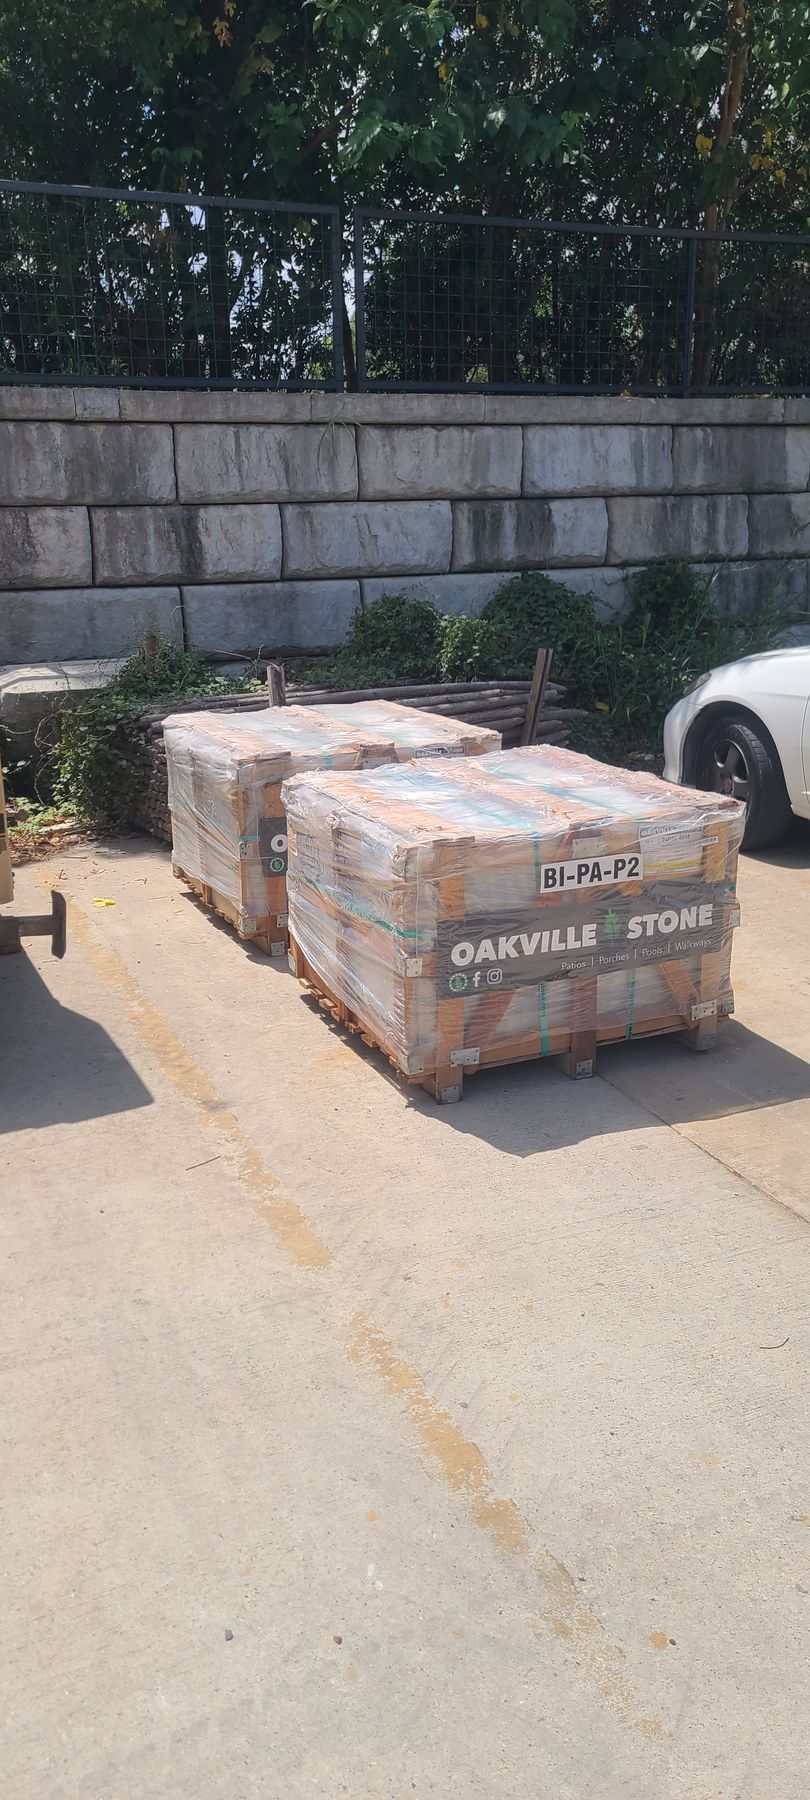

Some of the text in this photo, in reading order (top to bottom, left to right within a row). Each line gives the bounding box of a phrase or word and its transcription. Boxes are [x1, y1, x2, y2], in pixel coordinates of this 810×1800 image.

[543, 856, 640, 889] BI-PA-P2
[451, 904, 714, 966] OAKVILLE STONE
[561, 937, 712, 971] Patios Porches Pools Walkways
